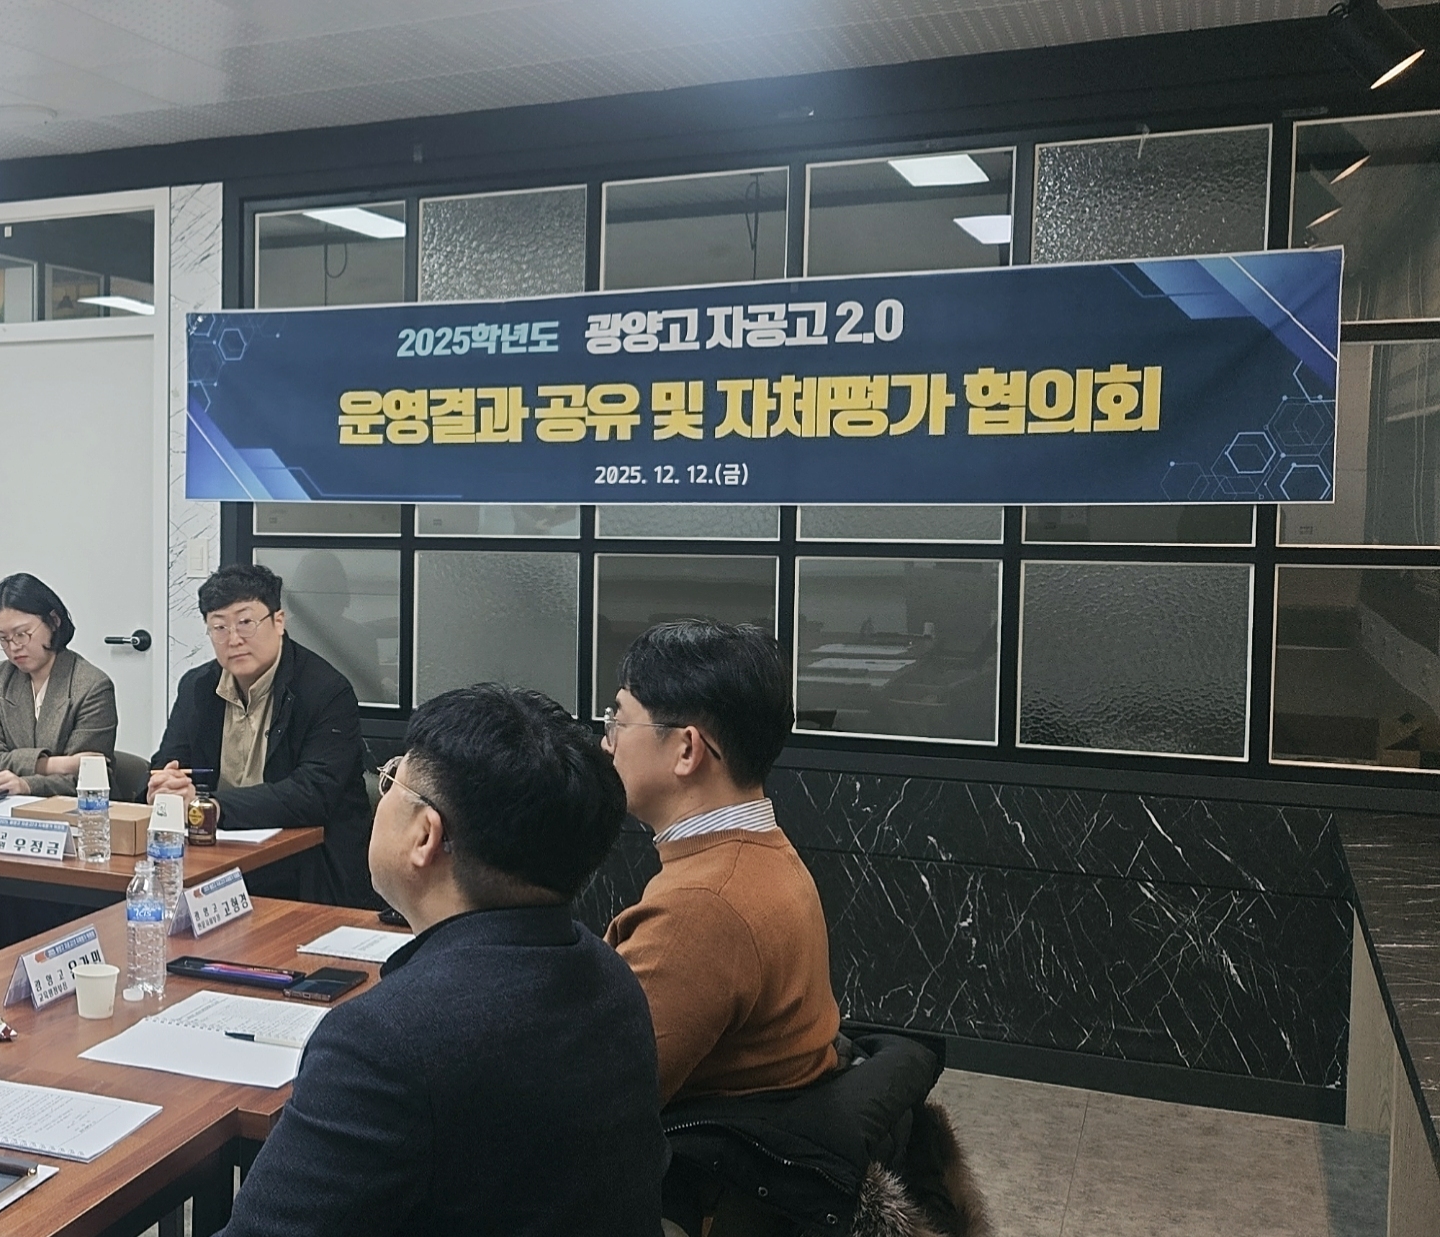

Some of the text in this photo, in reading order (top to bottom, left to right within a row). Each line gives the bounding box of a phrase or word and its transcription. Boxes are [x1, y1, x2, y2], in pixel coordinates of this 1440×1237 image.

[396, 299, 905, 358] 2025학년도 광양고 자공고 2.0
[337, 364, 1163, 446] 운영결과 공유 및 자체평가 협의회
[594, 463, 749, 486] 2025. 12. 12.(금)
[13, 838, 60, 856] 우정금
[221, 892, 249, 917] 고형경
